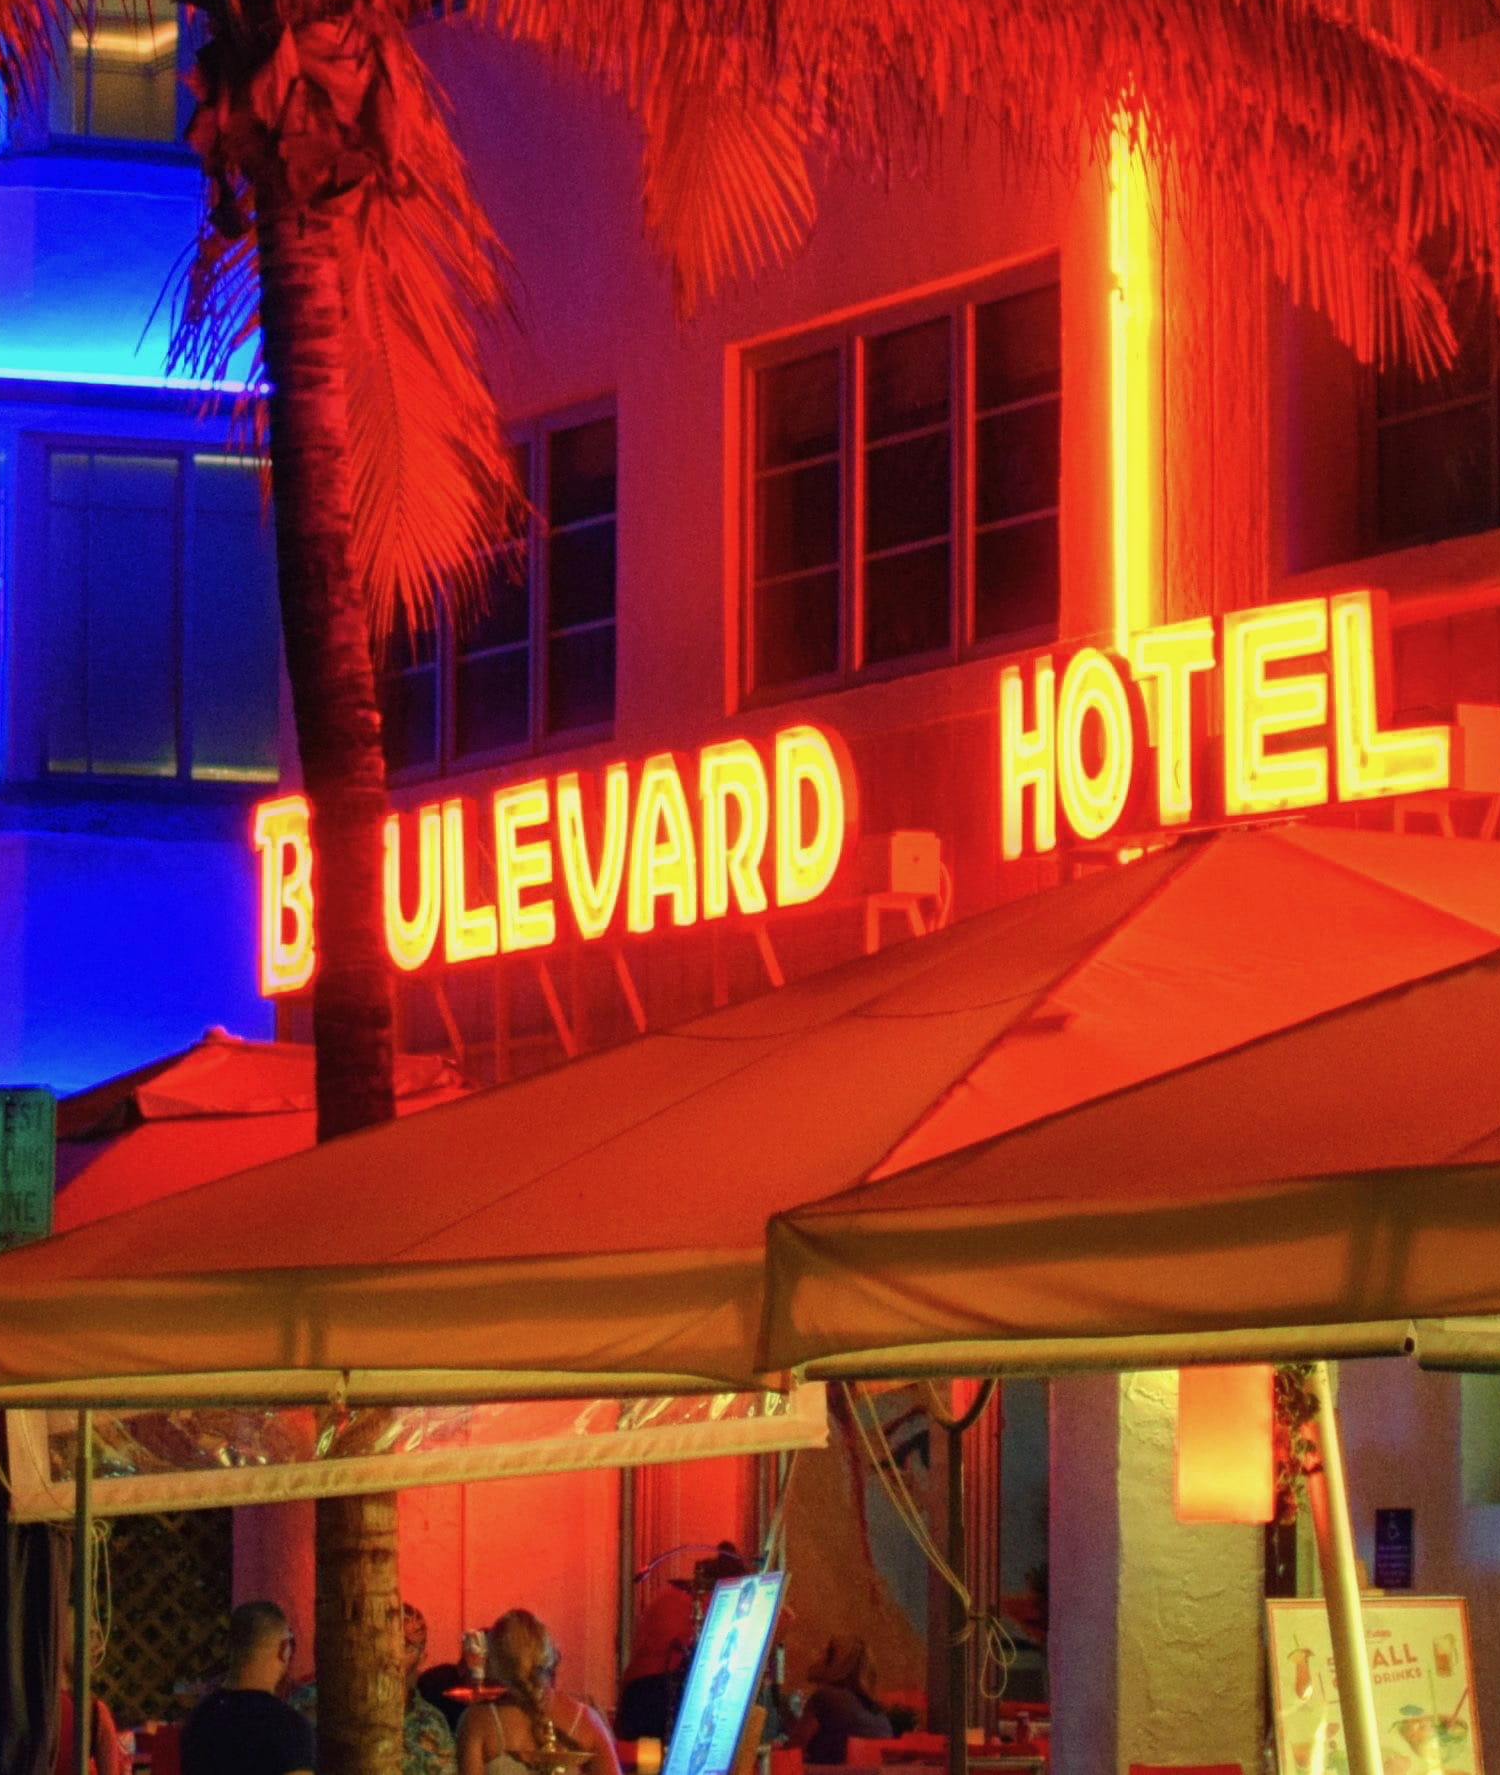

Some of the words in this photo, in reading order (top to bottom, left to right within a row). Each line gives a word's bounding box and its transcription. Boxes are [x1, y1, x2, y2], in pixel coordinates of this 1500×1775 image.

[255, 724, 846, 997] BULEVARD
[1000, 589, 1451, 861] HOTEL
[1371, 1642, 1418, 1670] ALL
[1373, 1667, 1423, 1686] DRINKS
